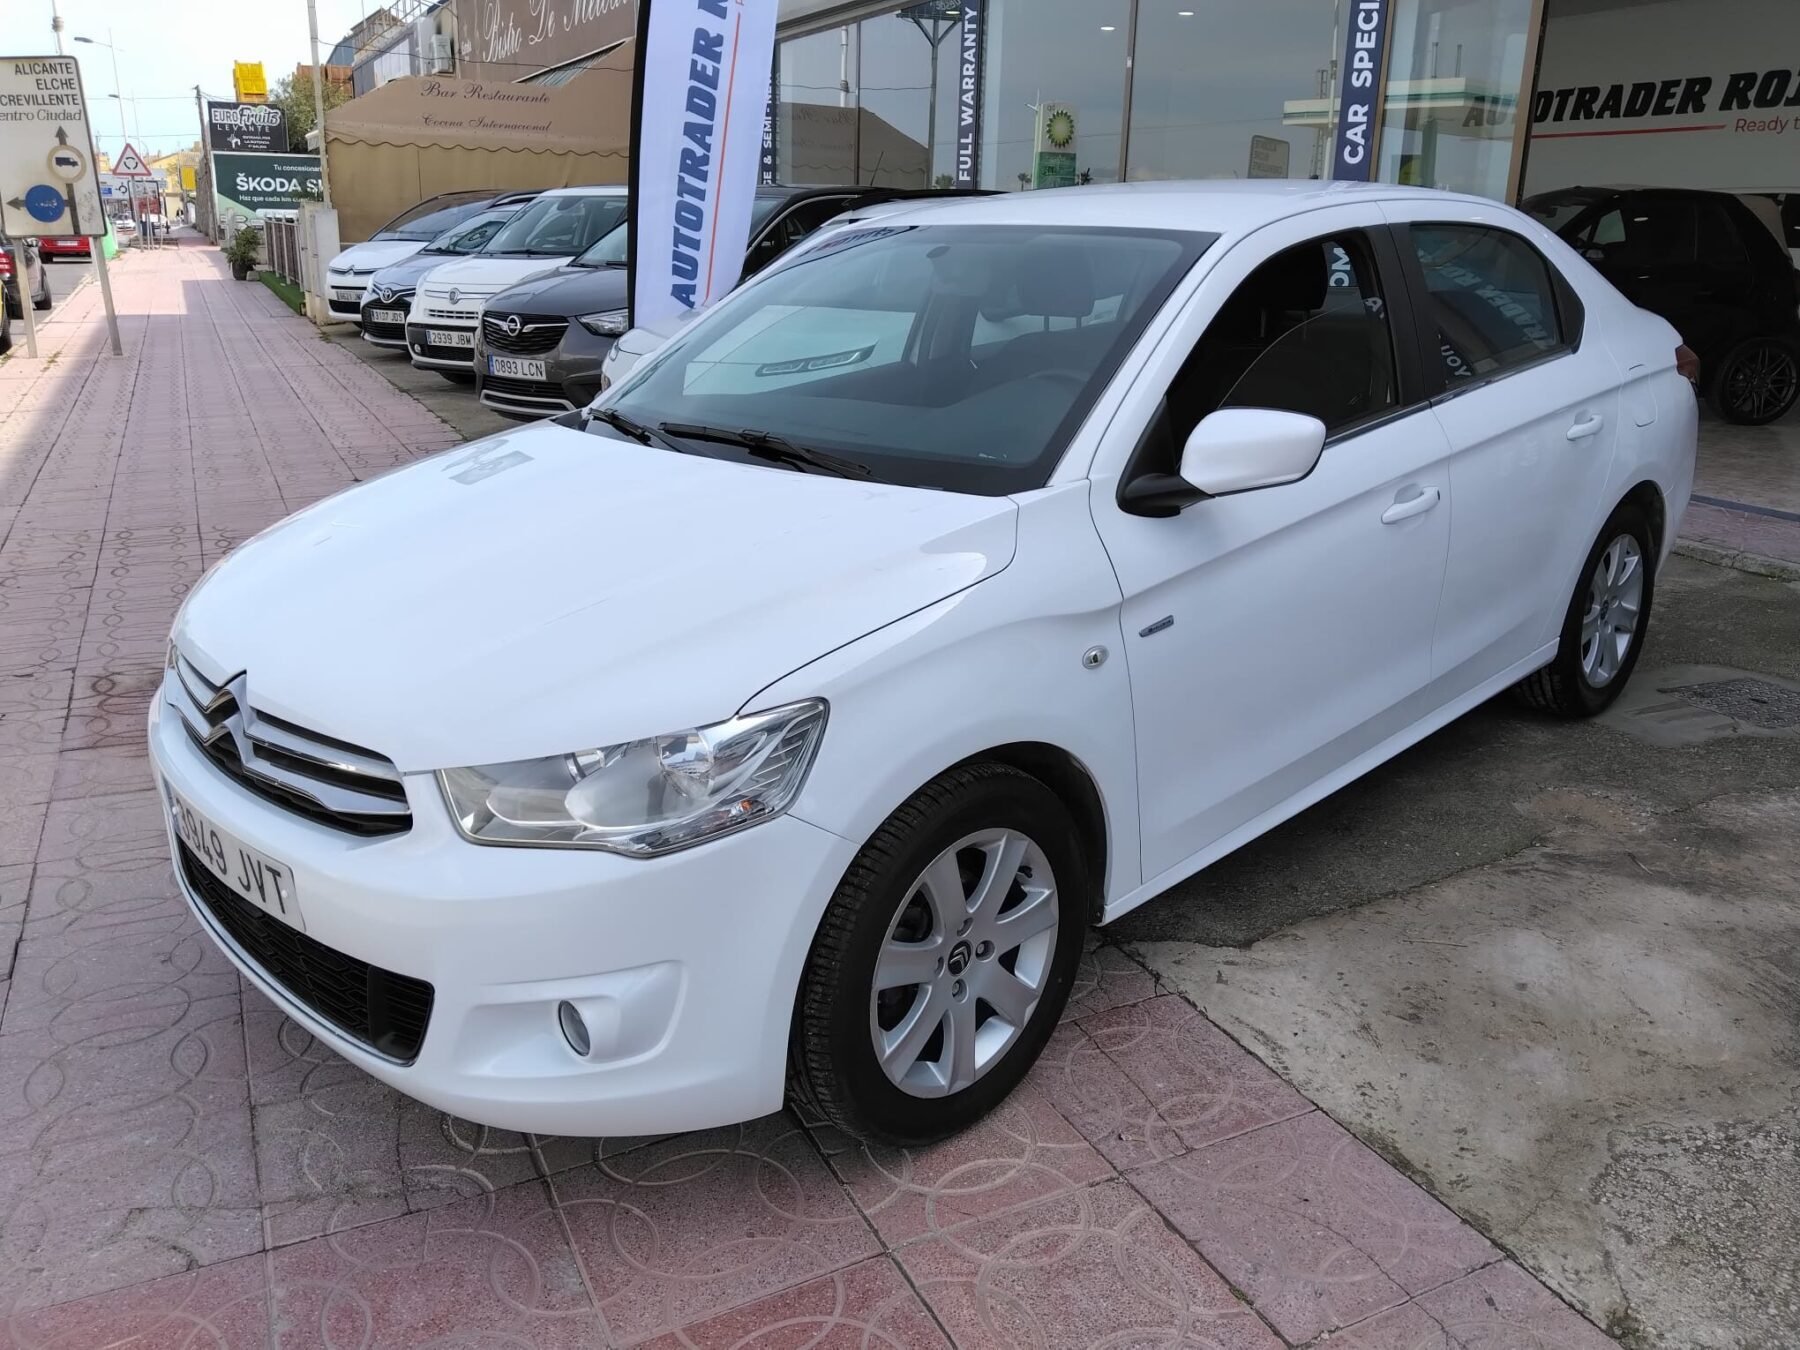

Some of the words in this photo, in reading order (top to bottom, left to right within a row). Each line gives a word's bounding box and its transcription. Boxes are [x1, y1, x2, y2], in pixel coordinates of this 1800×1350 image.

[483, 3, 522, 62] Bistro
[529, 0, 555, 45] De
[1351, 0, 1380, 88] SPECI
[14, 62, 74, 76] ALICANTE
[961, 7, 977, 126] WARRANTY
[35, 78, 77, 91] ELCHE
[420, 80, 458, 98] Bar
[463, 83, 550, 104] Restaurante
[0, 93, 80, 107] CREVILLENTE
[1462, 76, 1713, 128] AUOTRADER
[37, 108, 82, 121] Ciudad
[421, 113, 463, 127] Cocina
[468, 116, 553, 132] Internacional
[217, 124, 271, 133] LEVANTE
[1343, 104, 1369, 165] CAR
[1734, 116, 1789, 135] Ready
[763, 155, 772, 165] &
[959, 133, 974, 181] FULL
[670, 27, 724, 309] AUTOTRADER
[236, 172, 302, 193] ŠKODA
[239, 194, 251, 202] Haz
[432, 332, 453, 345] 2939
[456, 332, 472, 346] JBM
[494, 359, 519, 375] 0893
[521, 360, 544, 378] LCN
[238, 848, 286, 915] JVT
